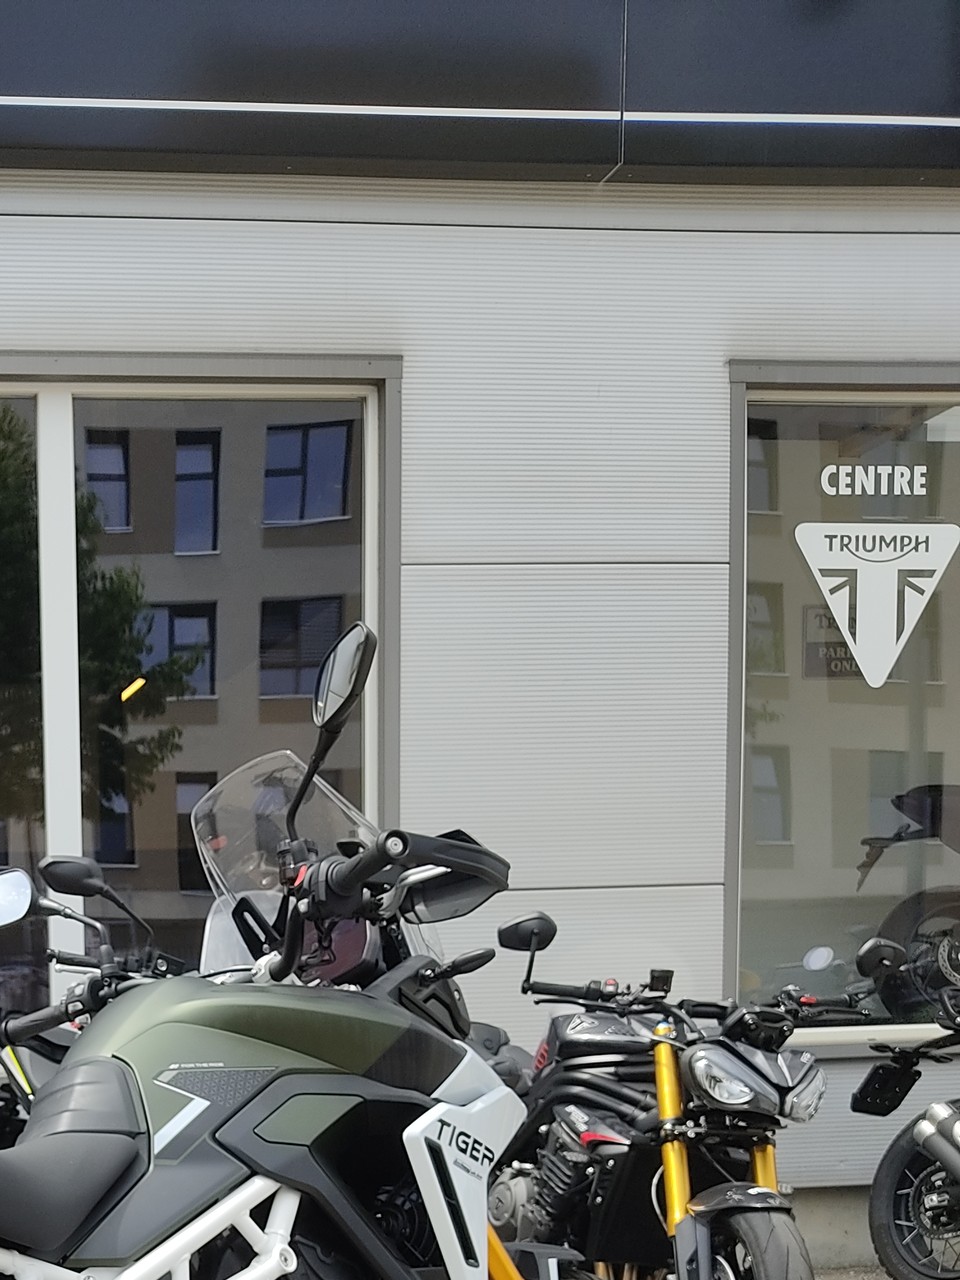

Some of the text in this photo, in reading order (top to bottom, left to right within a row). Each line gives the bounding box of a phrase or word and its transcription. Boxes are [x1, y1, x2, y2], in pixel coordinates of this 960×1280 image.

[820, 464, 928, 496] CENTRE
[824, 534, 930, 559] TRIUMPH
[830, 660, 859, 672] ONL
[436, 1117, 496, 1167] TIGER
